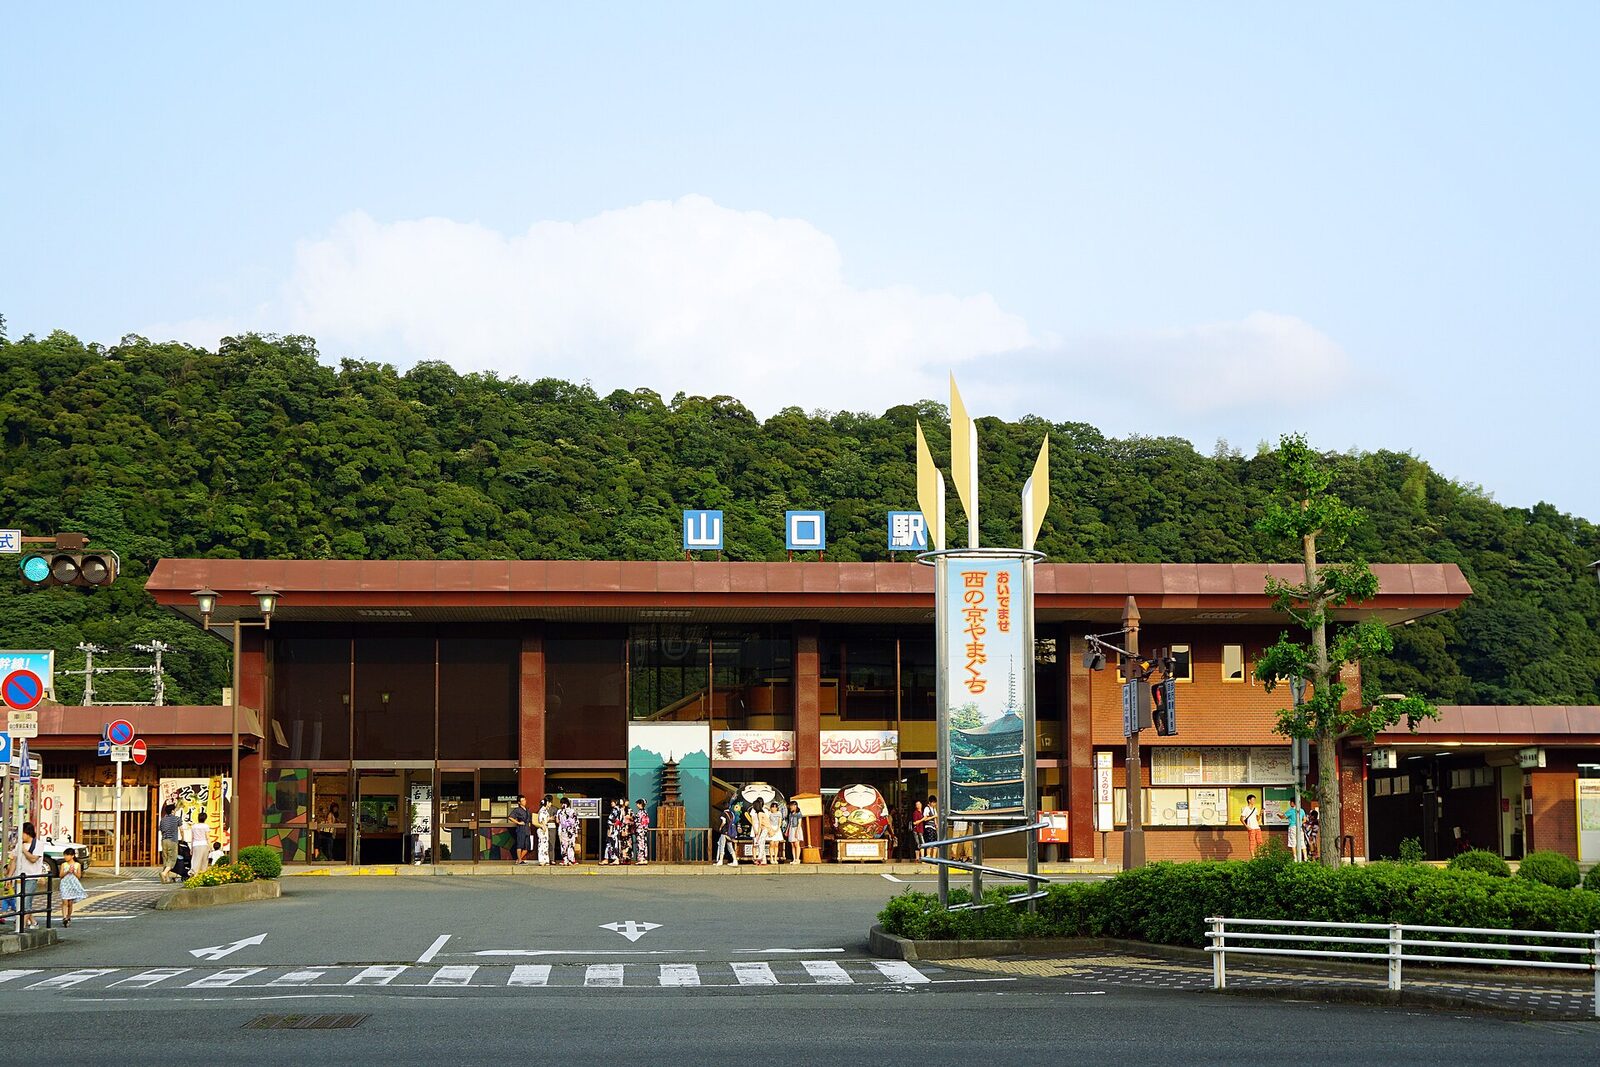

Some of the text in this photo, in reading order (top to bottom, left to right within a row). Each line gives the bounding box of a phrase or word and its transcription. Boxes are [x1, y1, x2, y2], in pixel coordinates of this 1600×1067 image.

[996, 571, 1010, 633] おいでませ
[961, 571, 988, 695] 西の京やまぐち
[733, 738, 790, 755] 幸せ運ぶ
[822, 739, 881, 754] 大内人形
